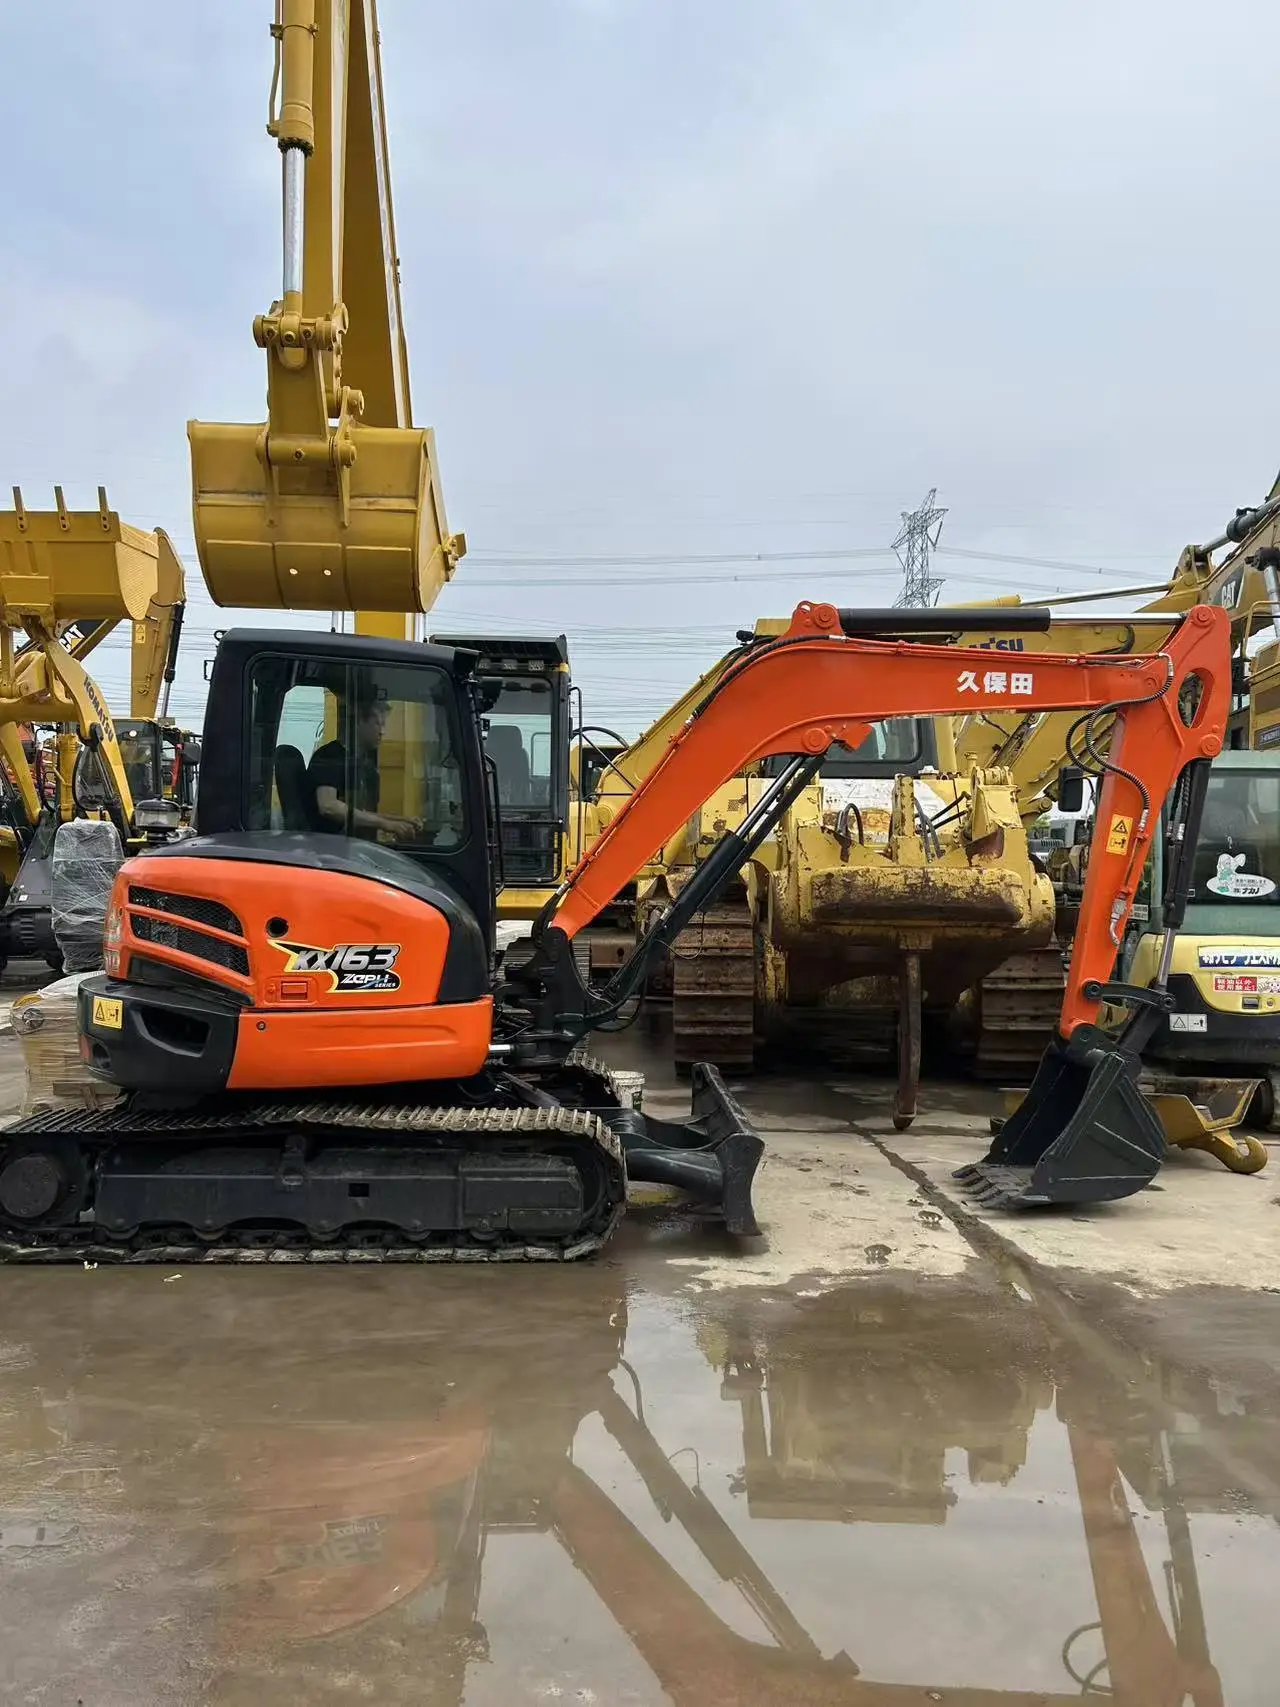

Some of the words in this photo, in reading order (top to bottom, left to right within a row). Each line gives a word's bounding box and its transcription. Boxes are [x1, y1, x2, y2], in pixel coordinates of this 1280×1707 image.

[1221, 581, 1237, 609] CAT
[59, 624, 86, 653] CAT
[956, 670, 1033, 695] 久保田
[83, 674, 114, 743] KOMATSU
[292, 945, 400, 971] KX163
